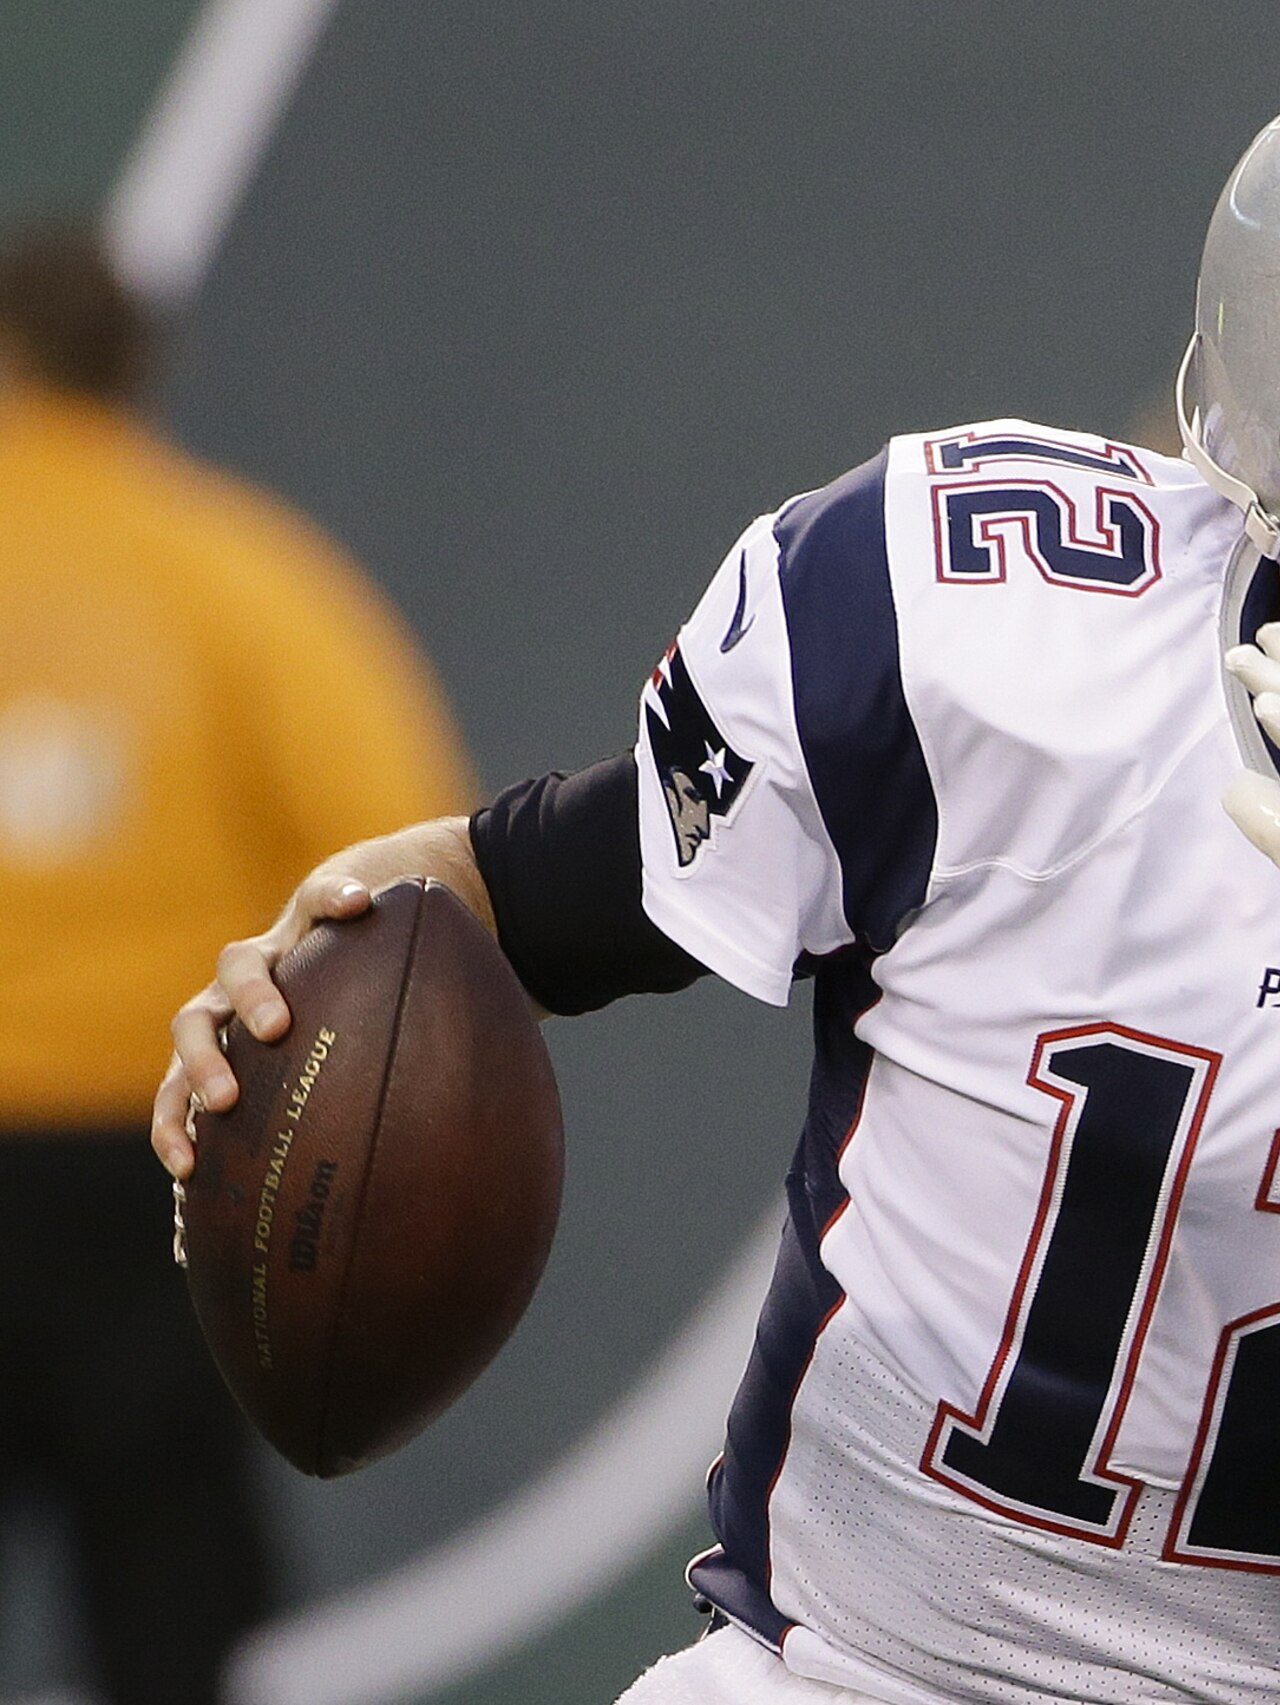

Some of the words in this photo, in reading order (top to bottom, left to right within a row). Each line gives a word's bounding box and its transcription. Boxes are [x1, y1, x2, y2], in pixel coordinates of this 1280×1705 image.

[924, 431, 1162, 597] 12
[286, 1026, 336, 1120] LEAGUE
[254, 1128, 294, 1253] FOOTBALL
[289, 1159, 337, 1273] Wilson
[253, 1263, 273, 1369] NATIONAL
